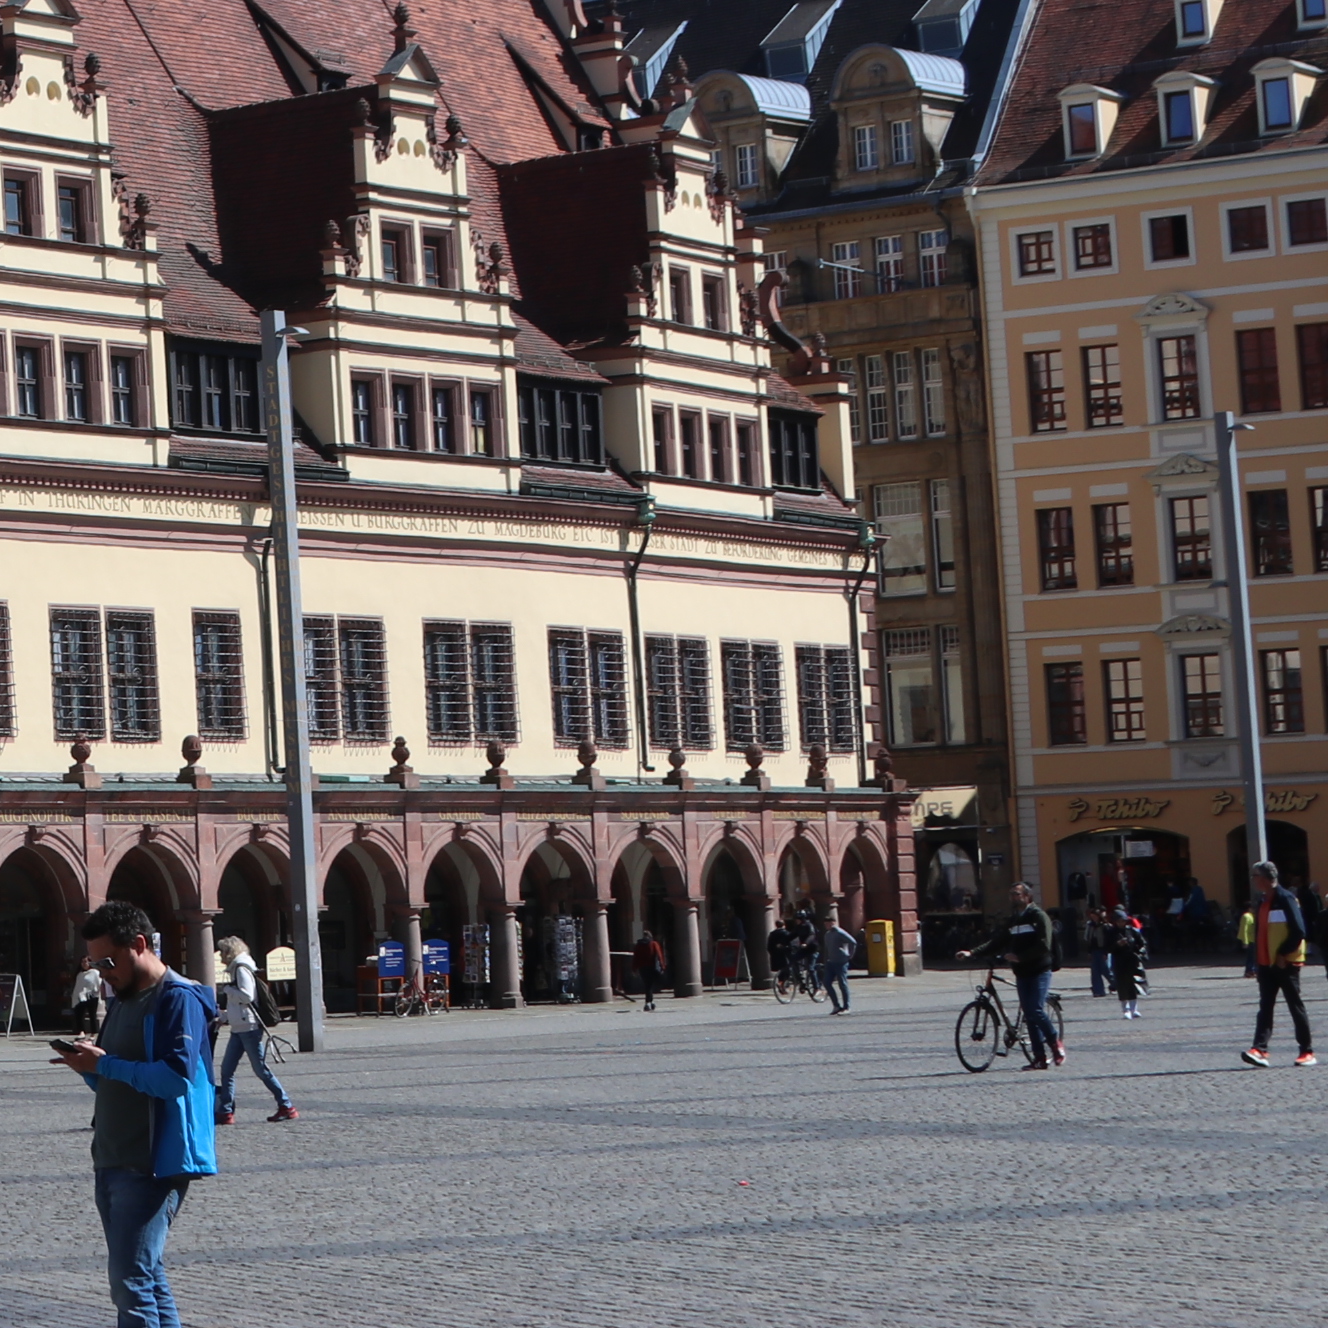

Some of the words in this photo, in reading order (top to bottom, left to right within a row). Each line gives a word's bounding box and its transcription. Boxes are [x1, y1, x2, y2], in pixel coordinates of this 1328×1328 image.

[18, 488, 35, 505] IN
[297, 510, 345, 528] EISSEN
[368, 514, 458, 533] BURGGRAFFEN
[468, 521, 485, 535] ZU
[494, 522, 567, 542] MAGDEBURG
[634, 532, 666, 550] DSER
[670, 536, 699, 553] STADT
[705, 540, 717, 555] ZU
[104, 807, 126, 823] TEE
[128, 807, 138, 822] &
[1096, 798, 1170, 820] Tchibo
